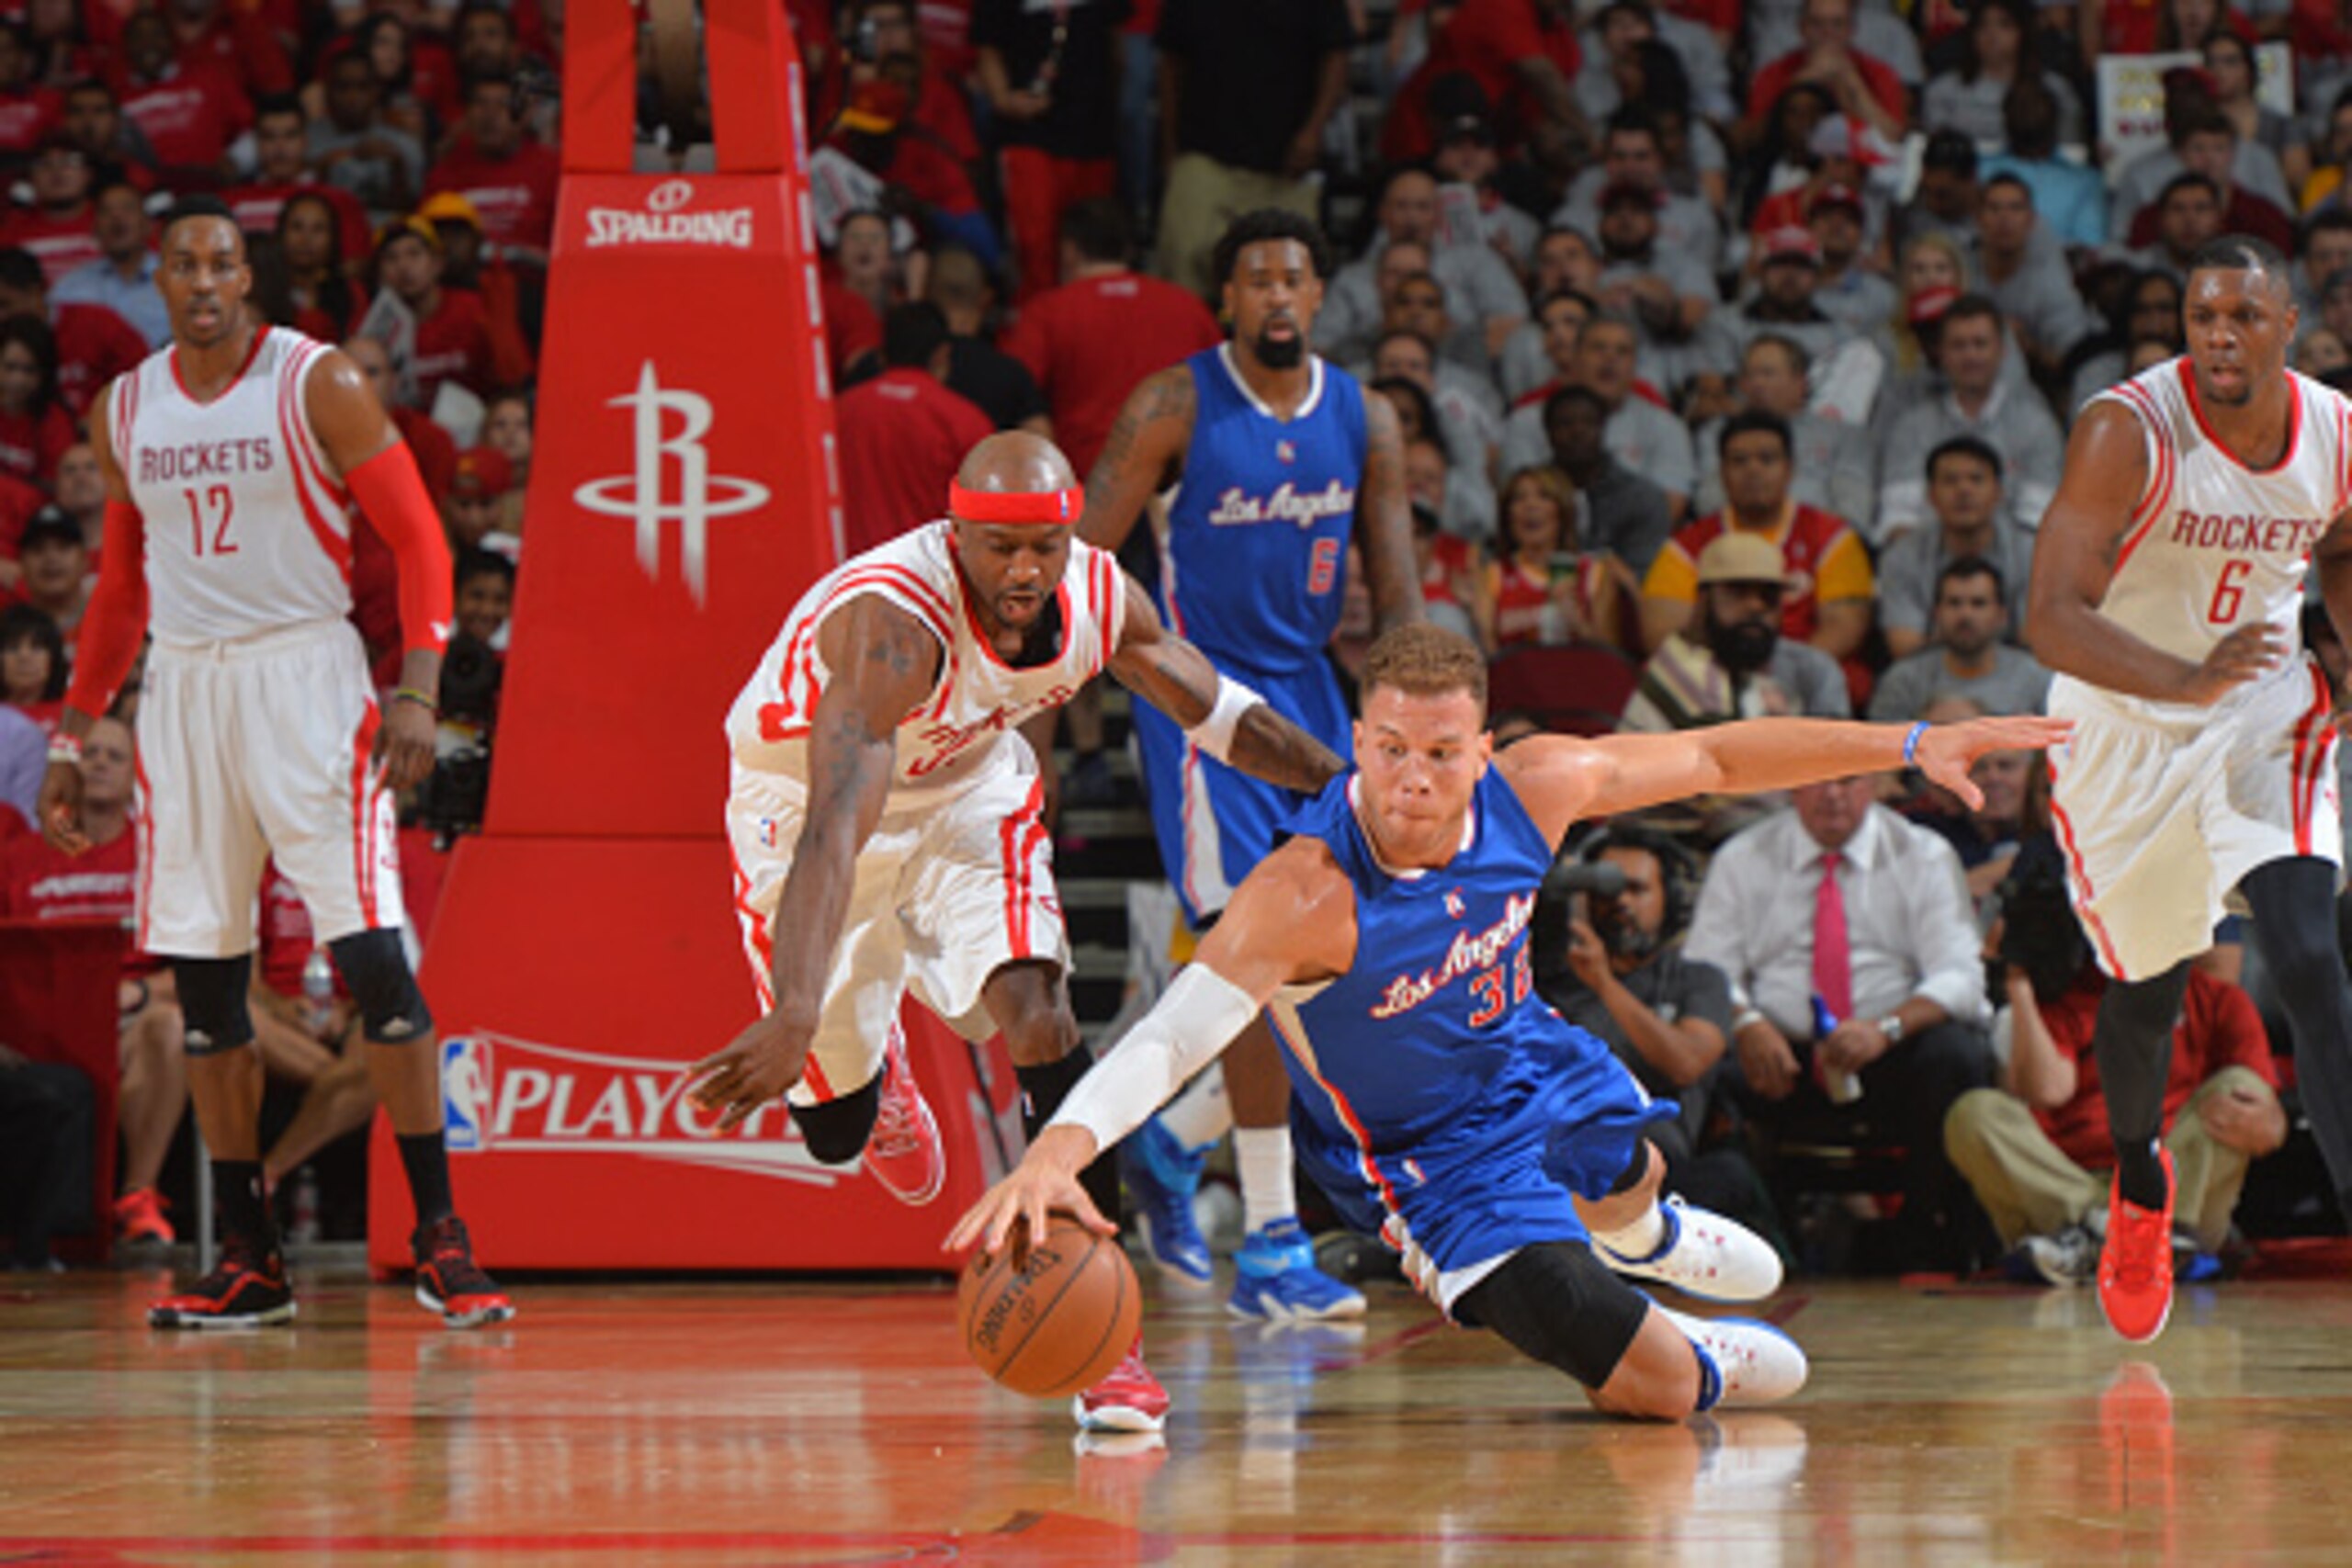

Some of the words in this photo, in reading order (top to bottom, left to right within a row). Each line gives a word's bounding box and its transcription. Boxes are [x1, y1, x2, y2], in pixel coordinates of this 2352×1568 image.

[586, 206, 753, 249] SPALDING
[140, 435, 275, 485] ROCKETS
[183, 482, 239, 558] 12
[1208, 486, 1261, 526] Los
[2170, 510, 2323, 553] ROCKETS
[1307, 537, 1340, 595] 6
[2207, 558, 2255, 625] 6
[1369, 972, 1436, 1020] Los
